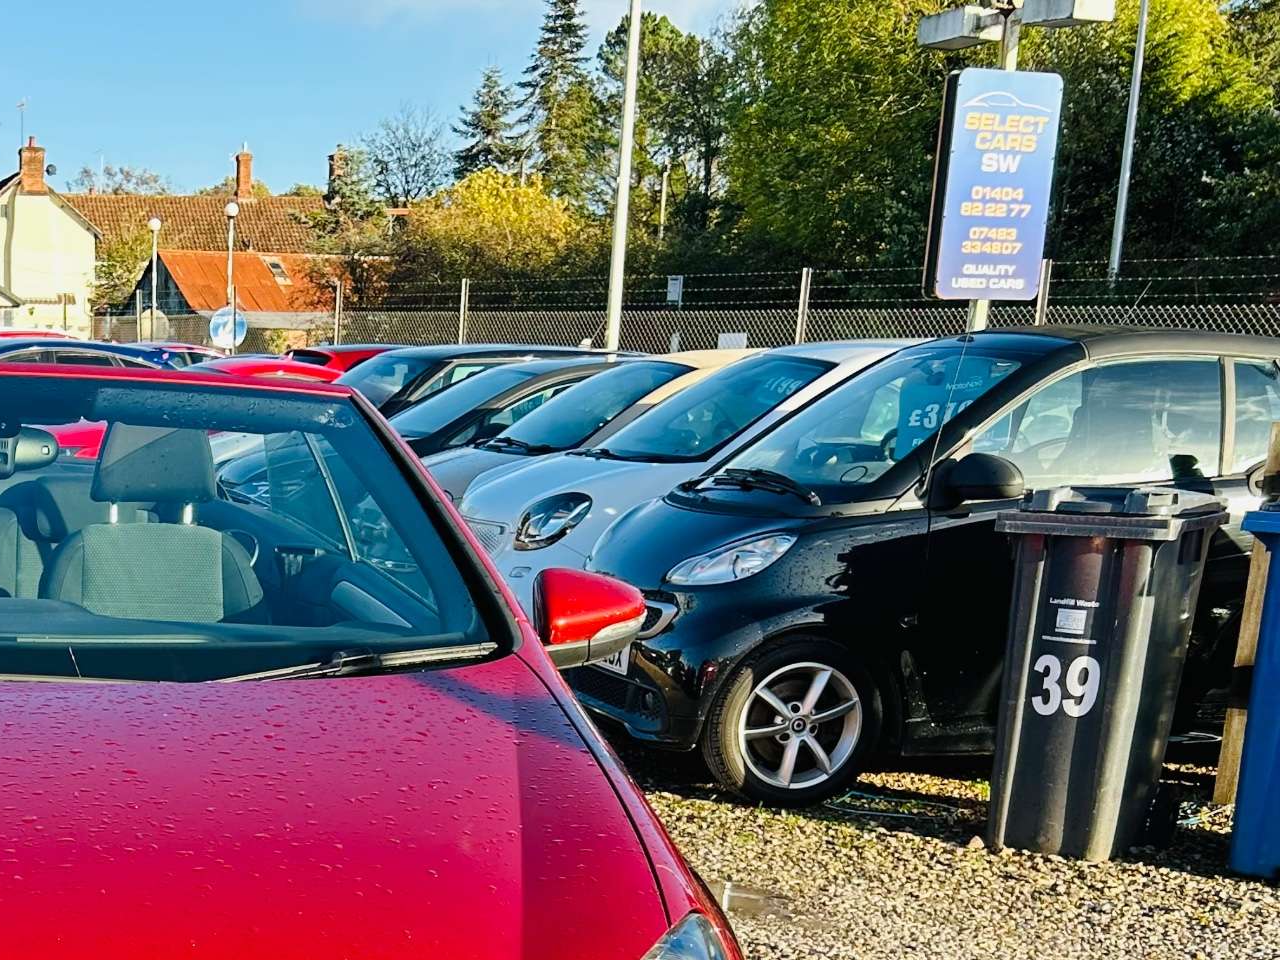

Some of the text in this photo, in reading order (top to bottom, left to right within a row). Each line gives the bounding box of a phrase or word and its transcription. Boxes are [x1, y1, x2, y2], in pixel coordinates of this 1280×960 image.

[964, 112, 1050, 134] SELECT
[975, 133, 1039, 152] CARS
[981, 153, 1022, 173] SW
[971, 185, 1025, 201] 01404
[962, 263, 1017, 276] QUALITY
[951, 277, 1026, 290] USED CARS
[1031, 654, 1101, 718] 39
